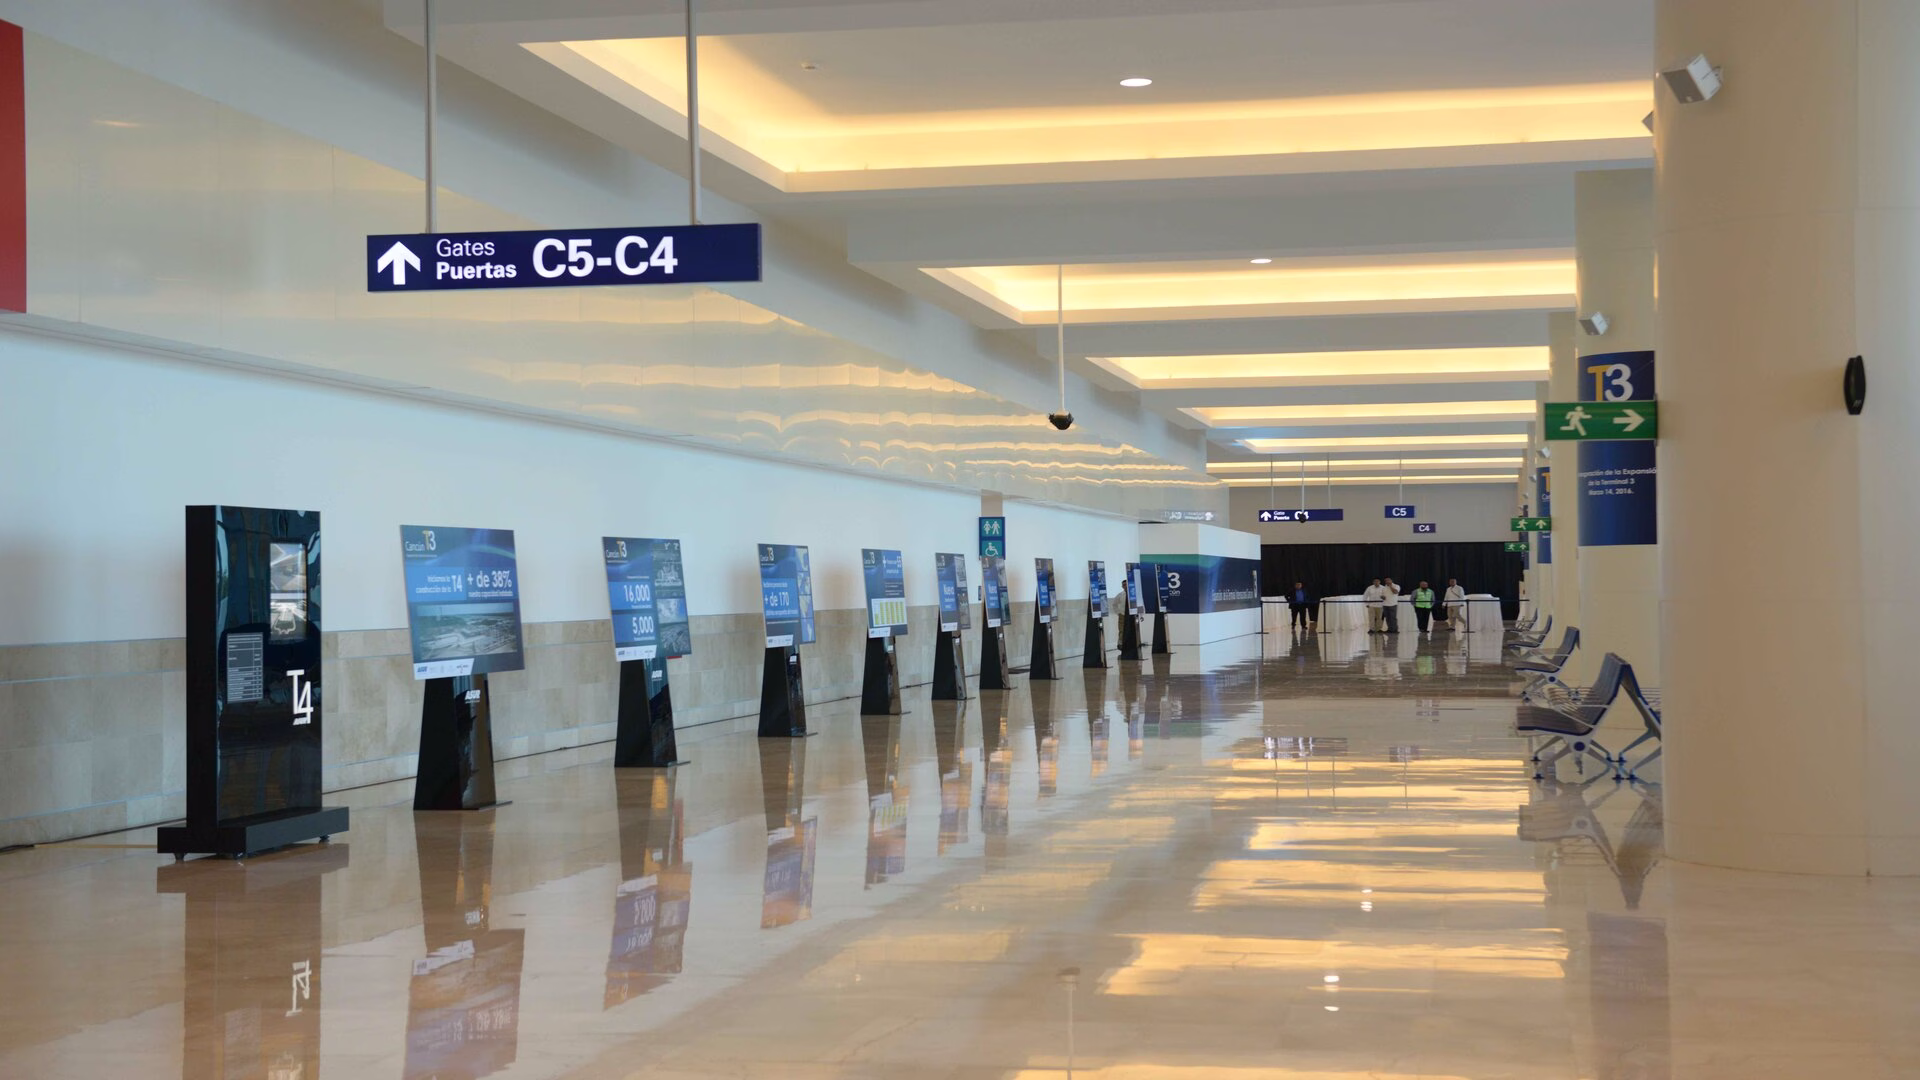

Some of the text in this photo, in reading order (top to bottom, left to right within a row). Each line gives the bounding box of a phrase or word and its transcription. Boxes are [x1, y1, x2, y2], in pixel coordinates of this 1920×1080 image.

[436, 238, 496, 258] Gates
[532, 235, 679, 278] C5-C4
[436, 262, 518, 281] Puertas
[1587, 363, 1634, 402] T3
[1392, 507, 1407, 517] C5
[422, 530, 436, 551] T3
[452, 575, 462, 592] T4
[476, 571, 490, 588] de
[492, 570, 512, 588] 38%
[1168, 572, 1181, 588] 3
[624, 584, 650, 604] 16,000
[770, 594, 778, 606] de
[779, 592, 790, 606] 170
[632, 616, 654, 635] 5,000
[286, 669, 314, 726] T4
